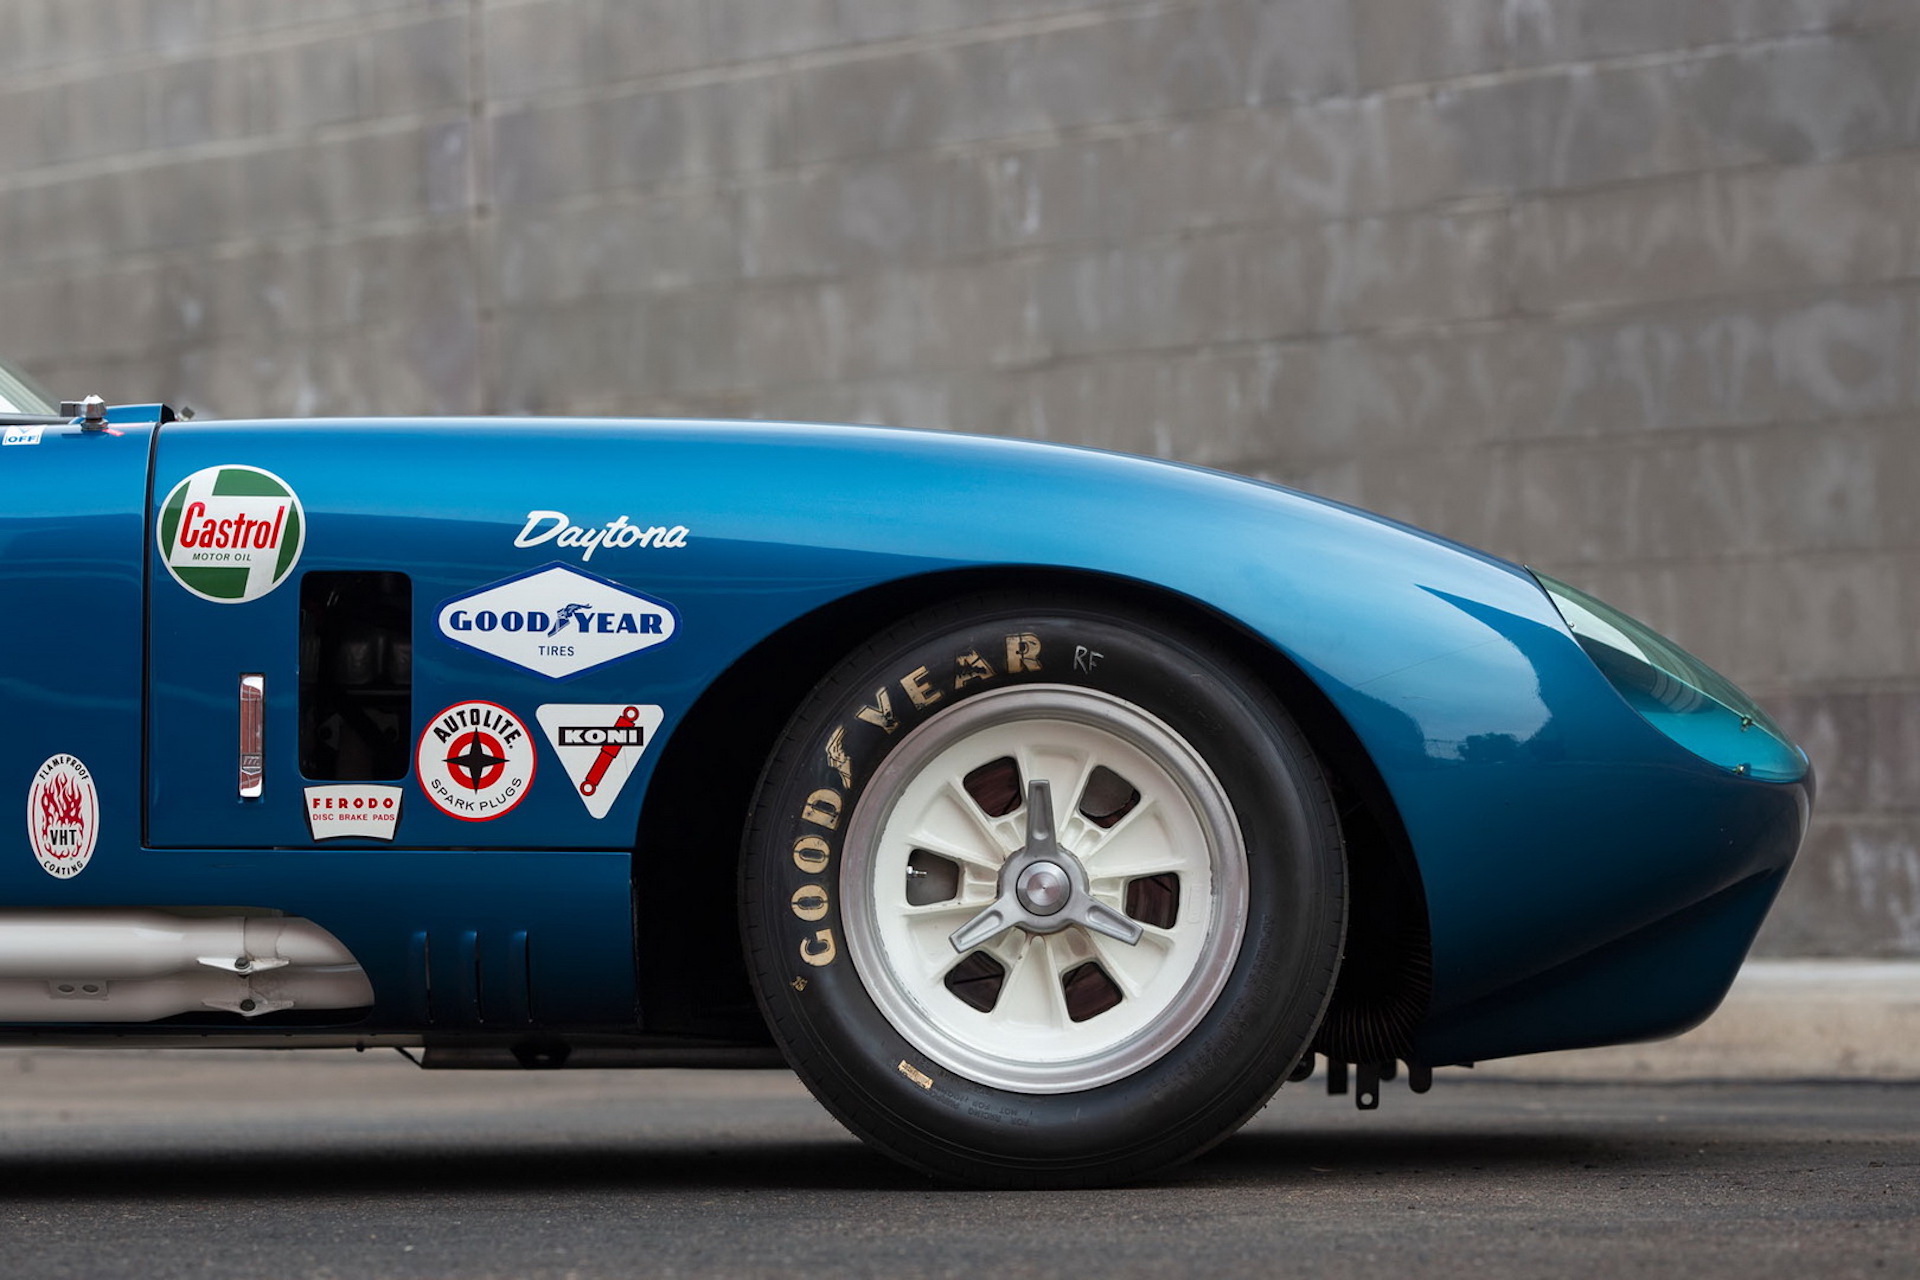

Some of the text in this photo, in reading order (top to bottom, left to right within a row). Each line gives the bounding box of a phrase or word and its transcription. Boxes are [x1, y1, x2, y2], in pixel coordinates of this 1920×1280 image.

[8, 435, 37, 443] OFF
[179, 501, 286, 550] Castrol
[513, 510, 690, 562] Daytona
[192, 552, 252, 562] MOTOR OIL
[538, 645, 575, 657] TIRES
[1073, 644, 1105, 675] RF
[564, 729, 638, 744] KONI
[39, 756, 90, 780] FLAMEPROOF
[431, 777, 522, 811] SPARK PLUGS
[312, 797, 394, 809] FERODO
[312, 813, 395, 821] DISC BRAKE PADS
[49, 829, 77, 846] VHT
[43, 860, 84, 876] COATING
